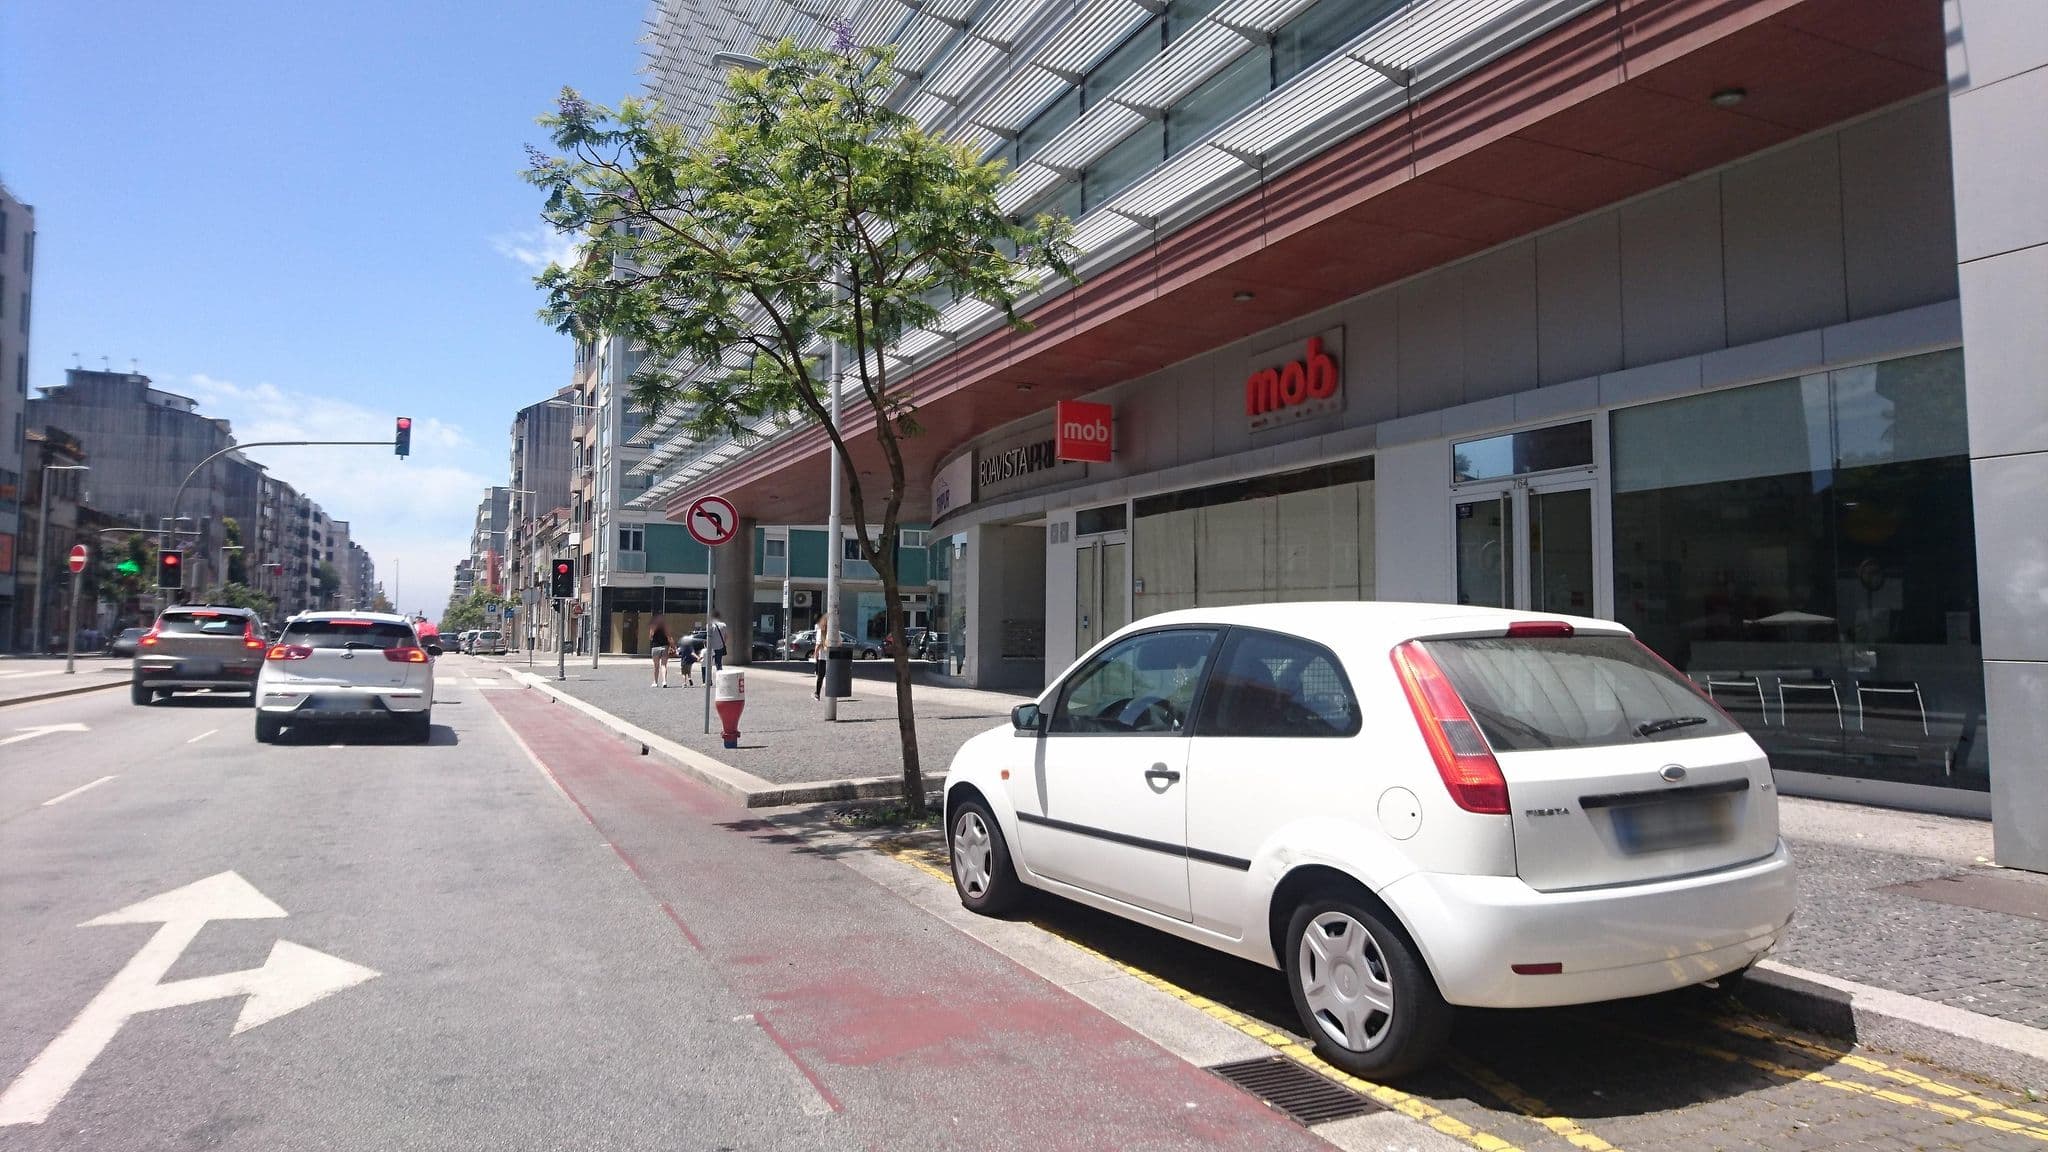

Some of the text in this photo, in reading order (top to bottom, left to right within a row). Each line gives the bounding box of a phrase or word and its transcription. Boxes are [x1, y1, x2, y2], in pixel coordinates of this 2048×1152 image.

[1247, 337, 1337, 415] mob
[1064, 419, 1109, 442] mob
[1526, 808, 1569, 817] FIESTA
